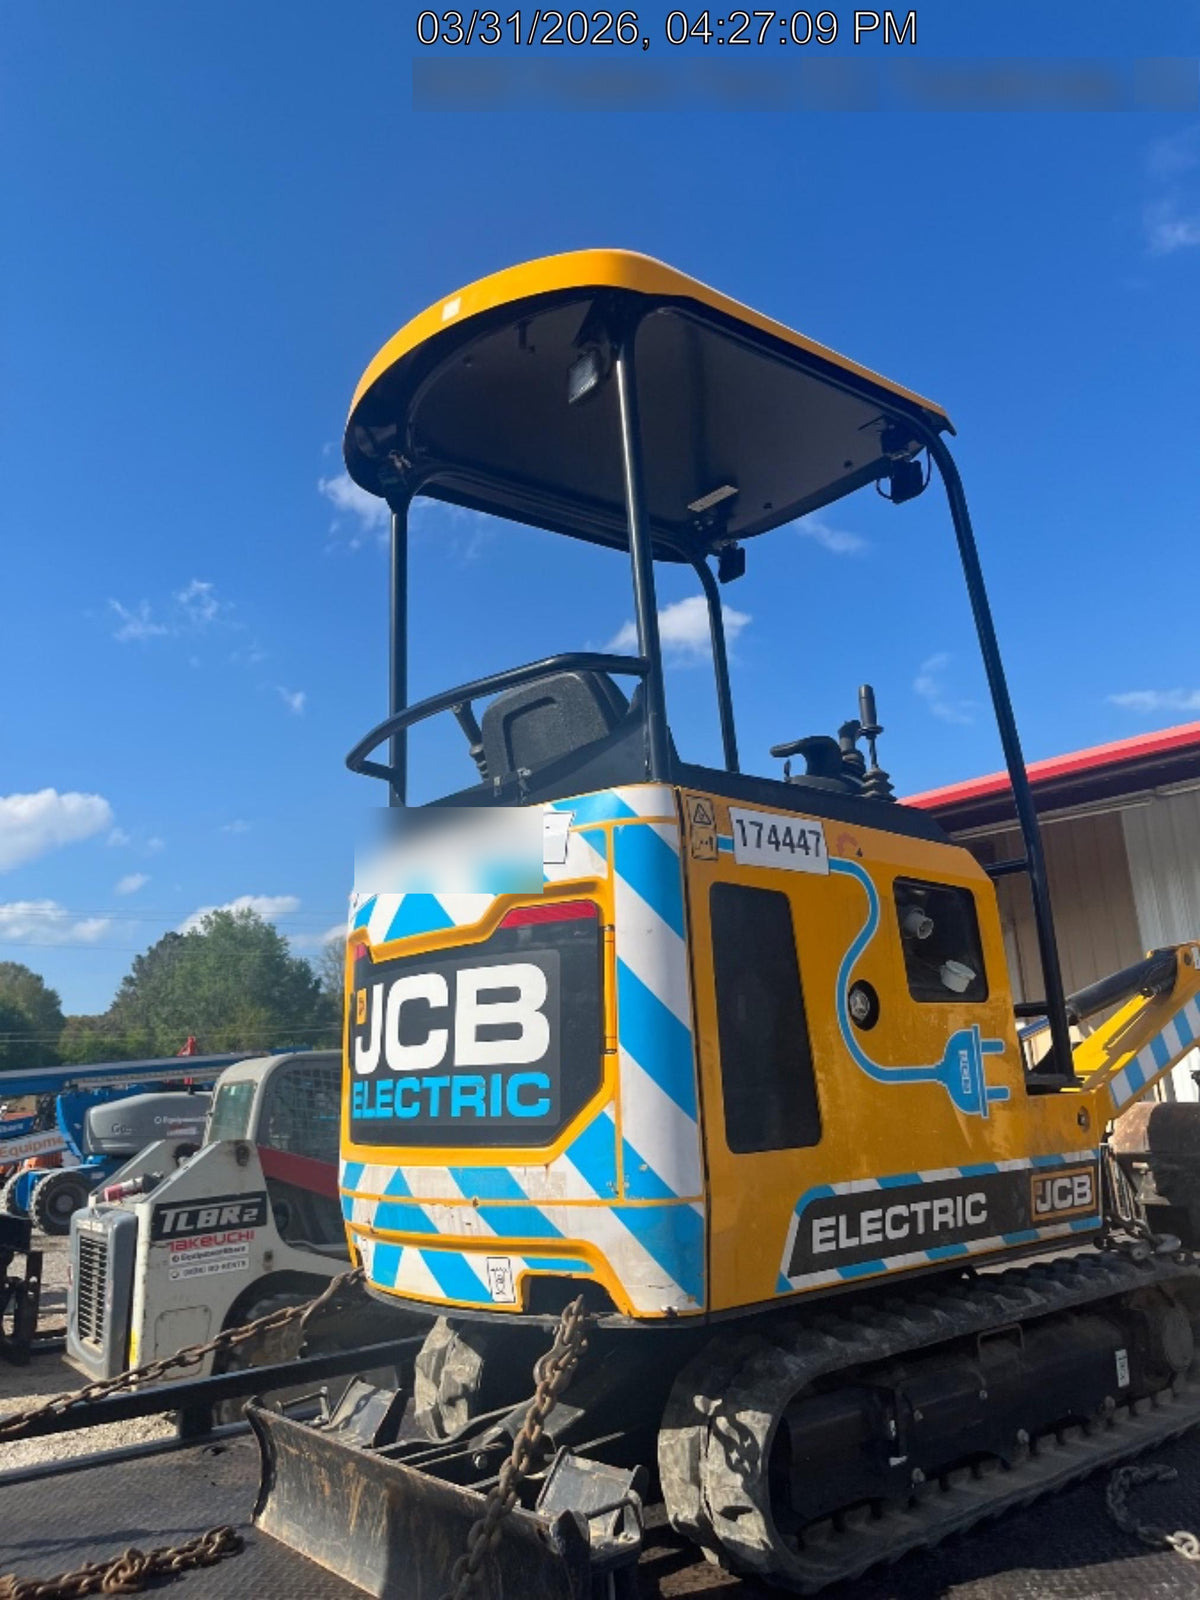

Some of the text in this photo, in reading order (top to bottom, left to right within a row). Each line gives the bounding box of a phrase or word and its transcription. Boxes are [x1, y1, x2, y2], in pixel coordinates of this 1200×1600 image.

[735, 818, 821, 858] 174447
[354, 962, 550, 1075] JCB
[351, 1071, 550, 1119] ELECTRIC
[1035, 1174, 1092, 1213] JCB
[811, 1192, 988, 1254] ELECTRIC
